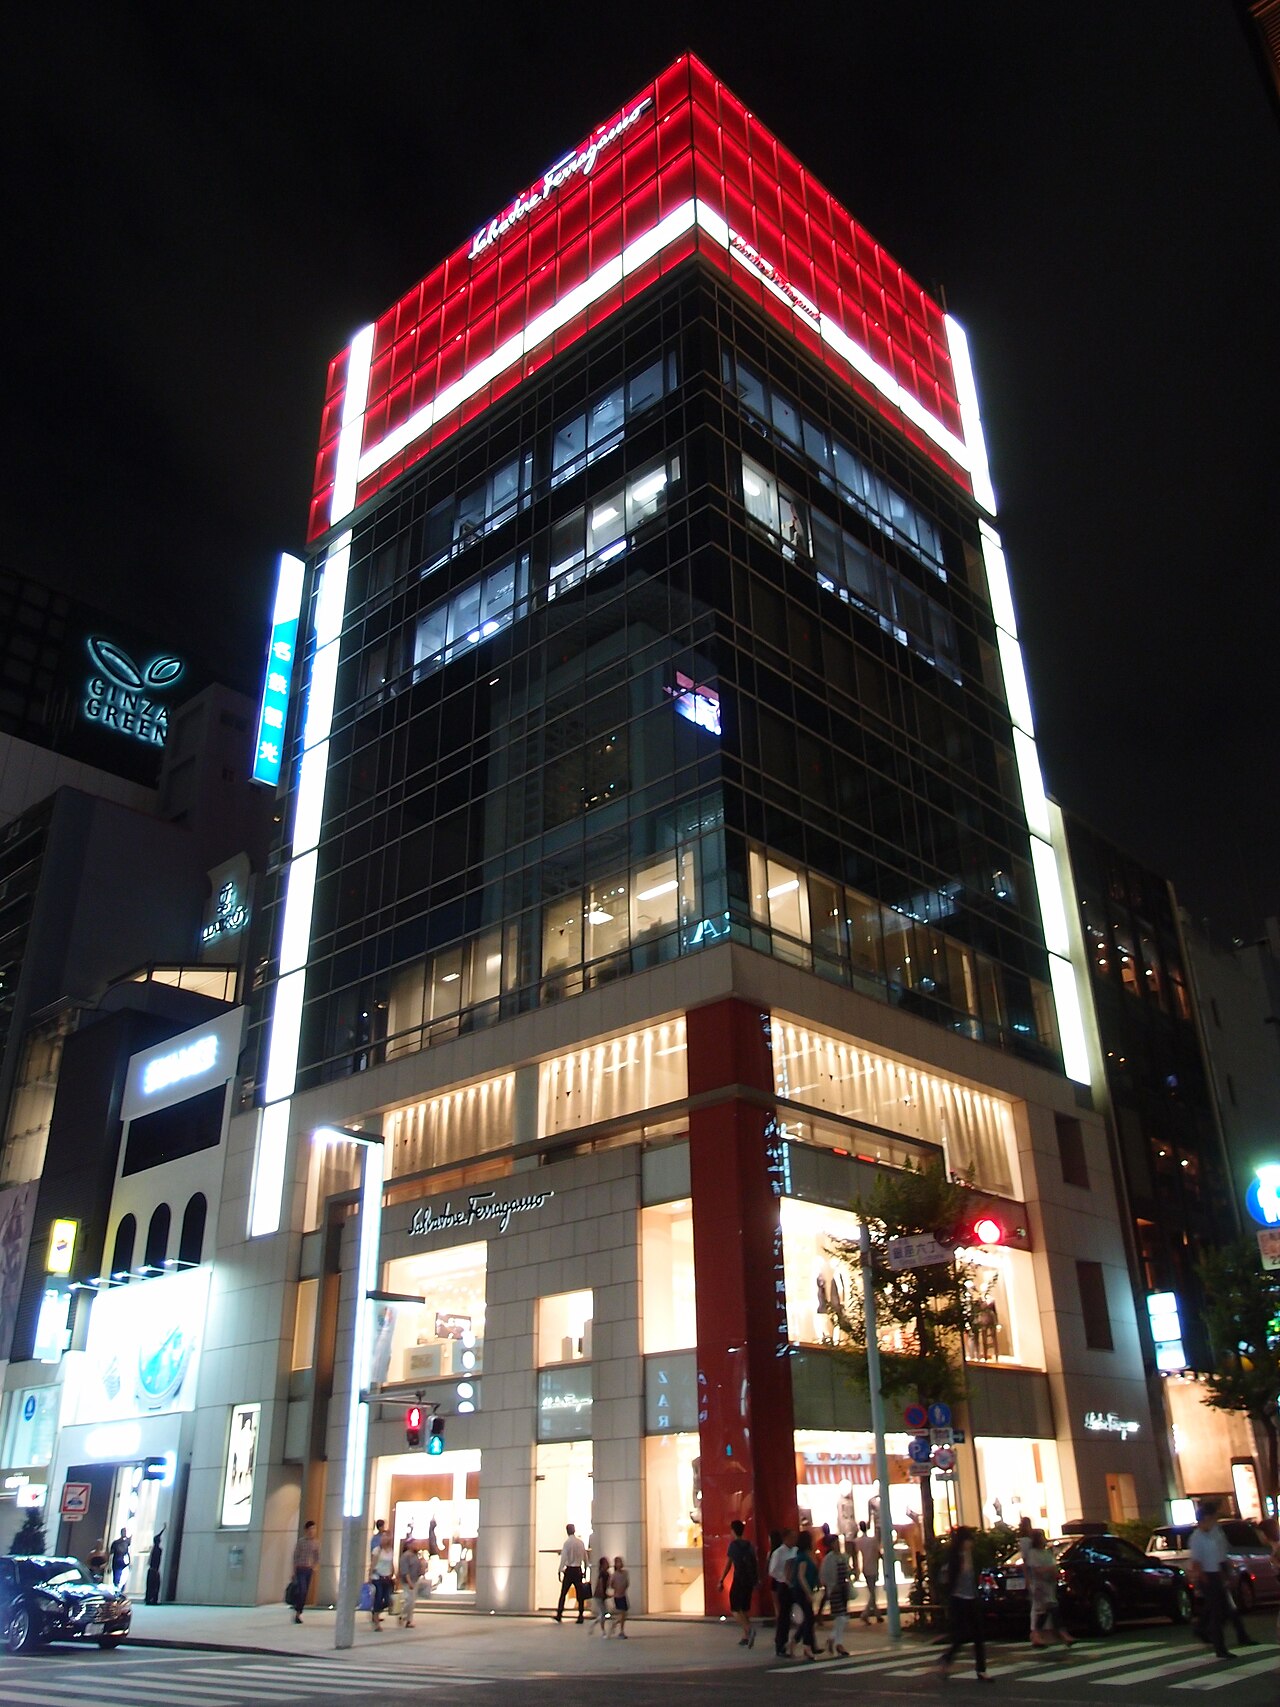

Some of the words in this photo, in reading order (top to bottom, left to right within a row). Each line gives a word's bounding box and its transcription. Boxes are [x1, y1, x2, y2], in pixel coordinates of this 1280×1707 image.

[86, 697, 169, 746] GREEN
[90, 677, 170, 726] GINZA
[408, 1202, 468, 1237] Salvatore
[467, 1191, 555, 1233] Ferragamo
